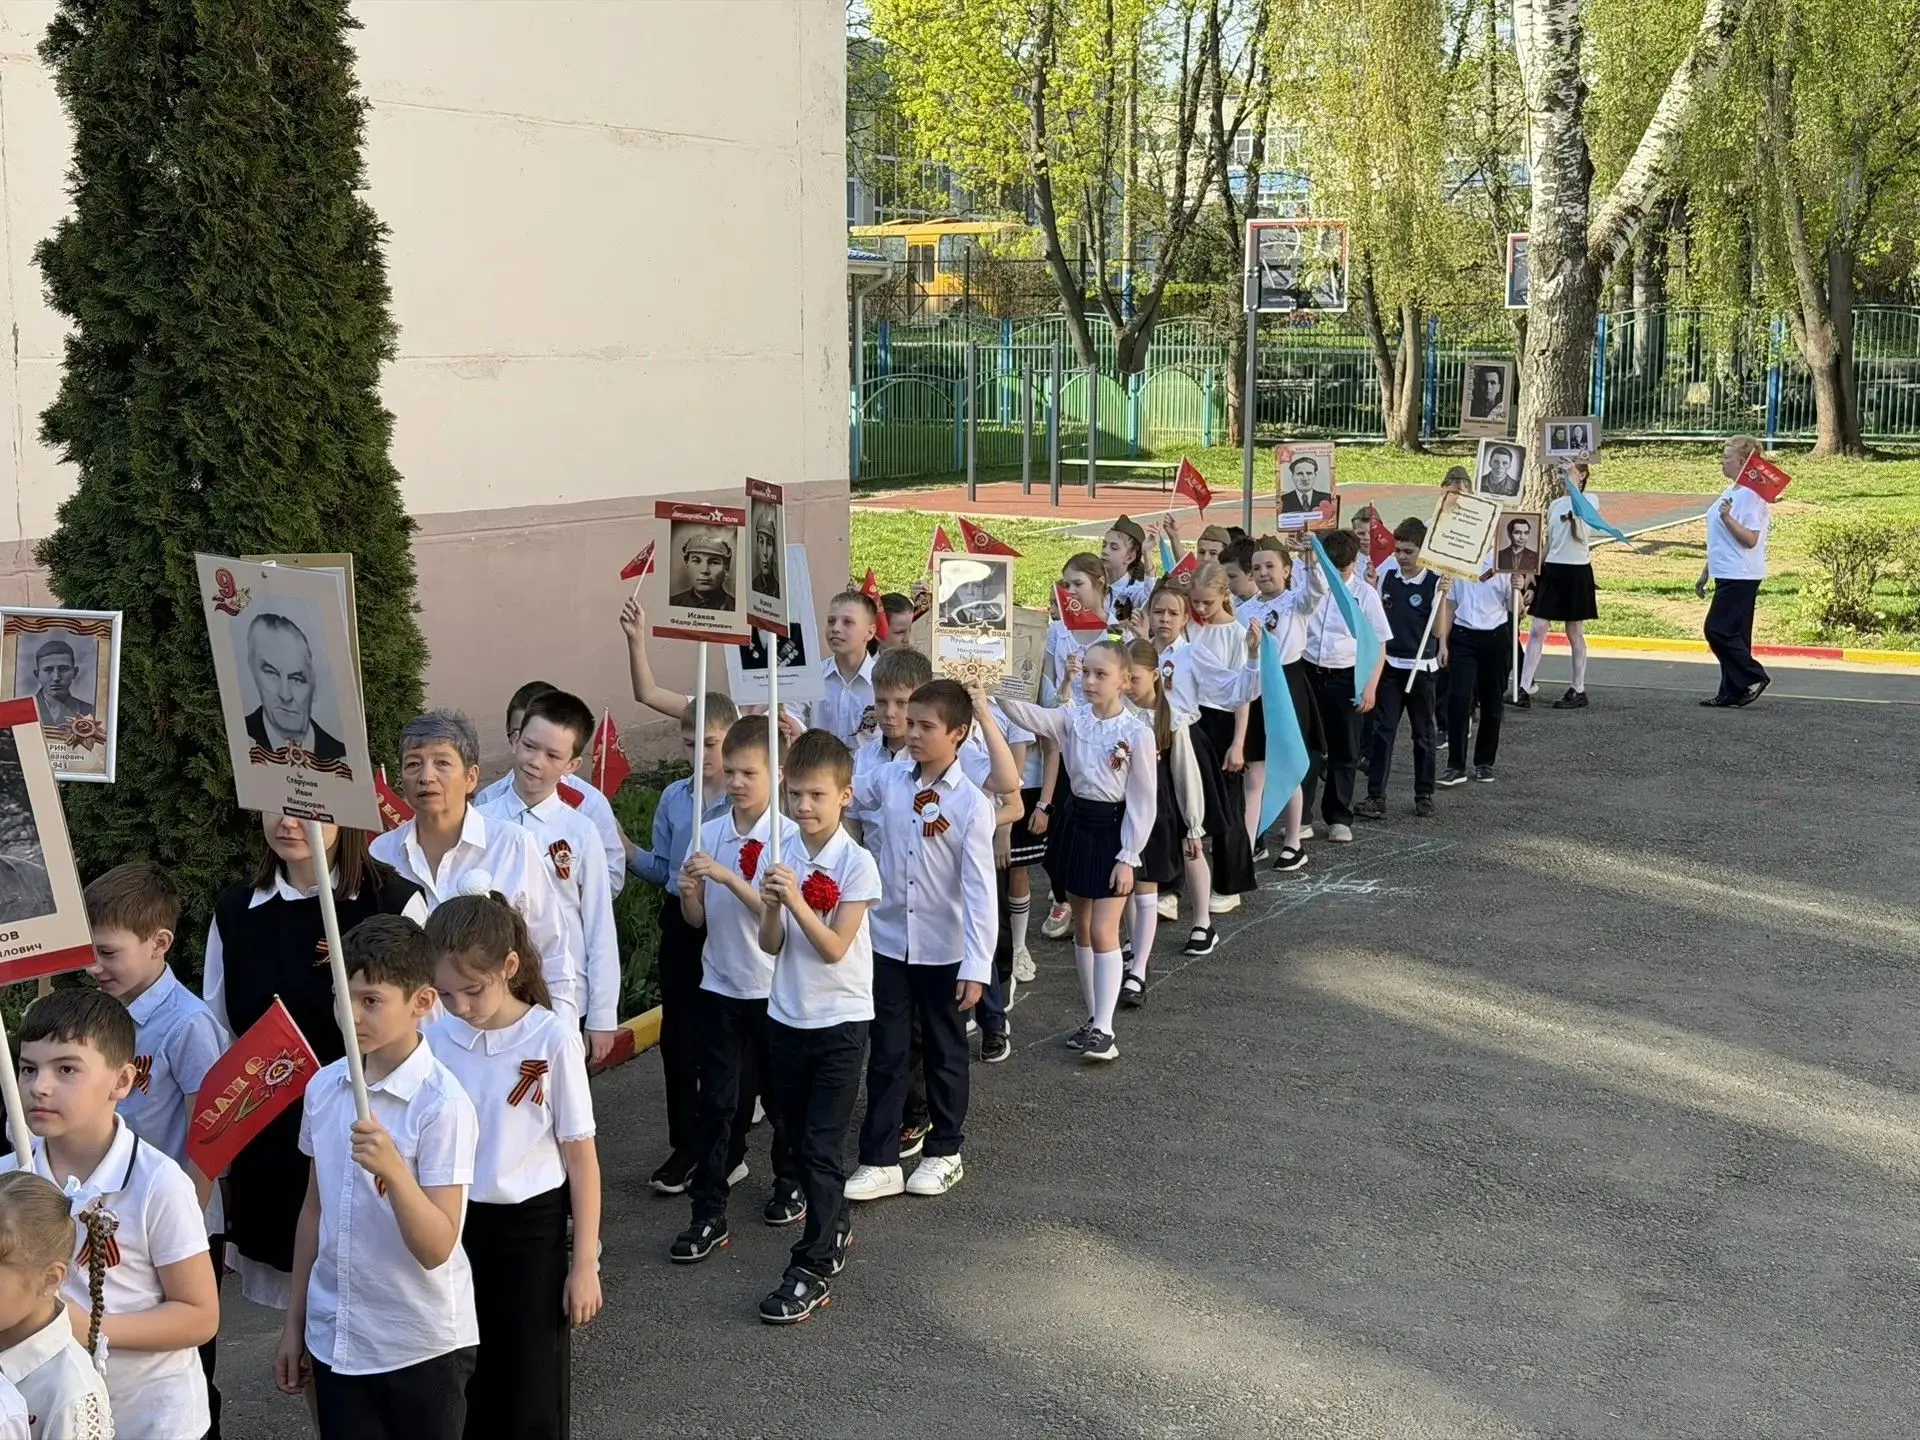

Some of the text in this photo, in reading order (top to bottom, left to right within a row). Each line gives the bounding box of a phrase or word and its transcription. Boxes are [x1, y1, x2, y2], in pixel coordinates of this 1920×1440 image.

[687, 611, 716, 621] Исаков
[50, 753, 85, 761] ванович
[52, 761, 68, 769] 943
